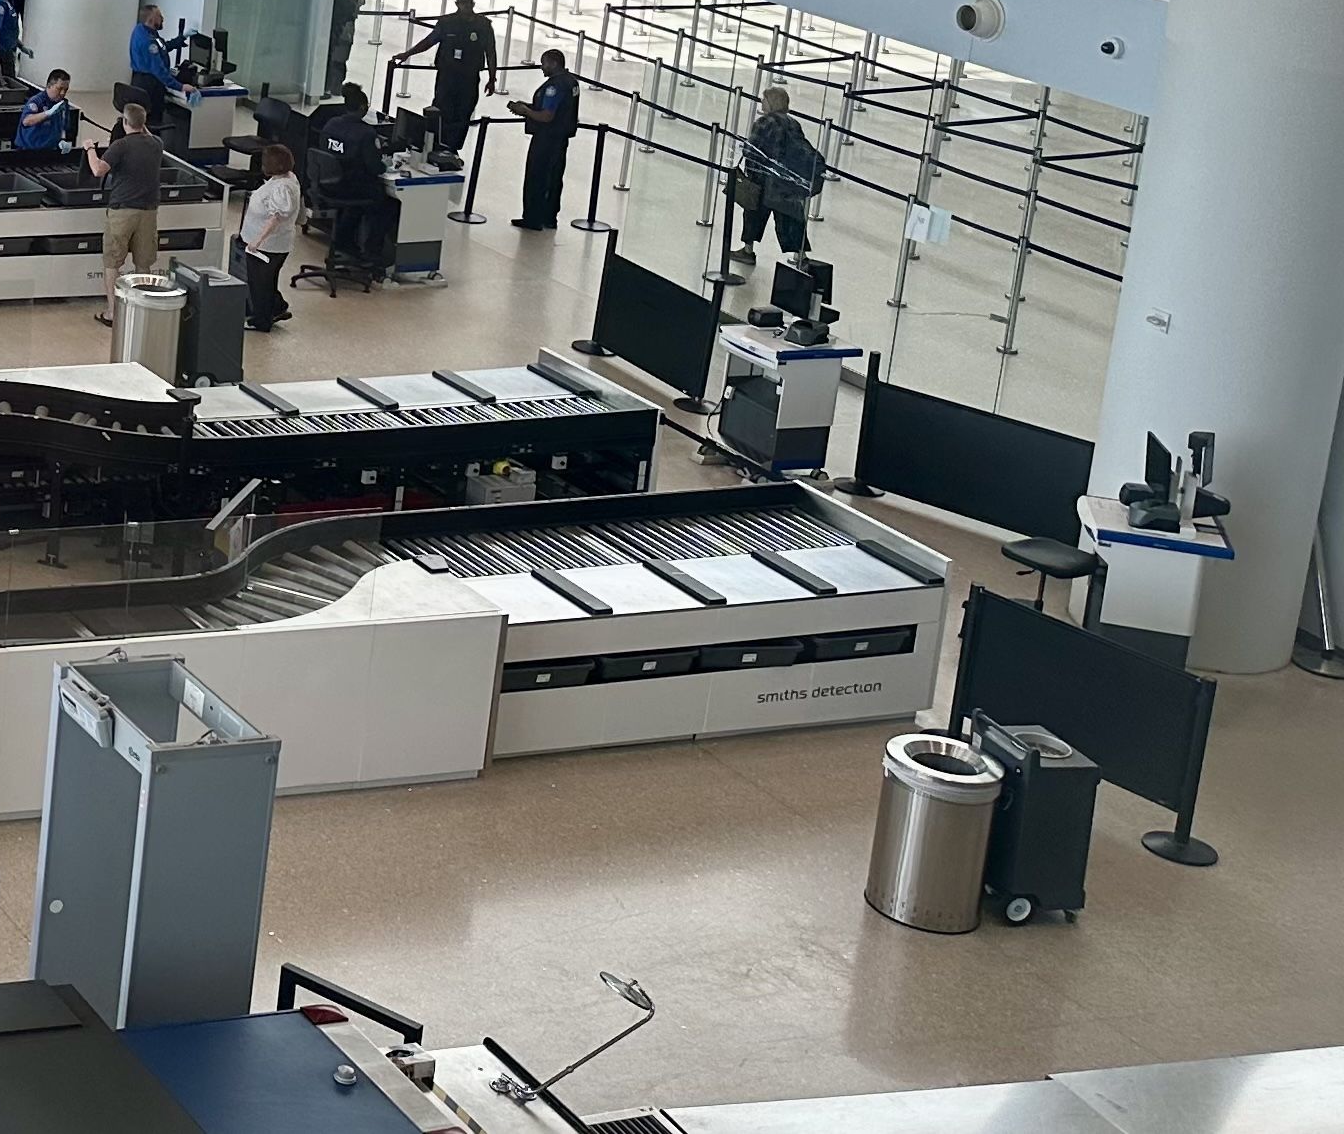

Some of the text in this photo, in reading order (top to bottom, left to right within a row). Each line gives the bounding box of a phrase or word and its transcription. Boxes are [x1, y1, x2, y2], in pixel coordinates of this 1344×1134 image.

[327, 138, 344, 153] TSA
[757, 682, 882, 704] smiths detection
